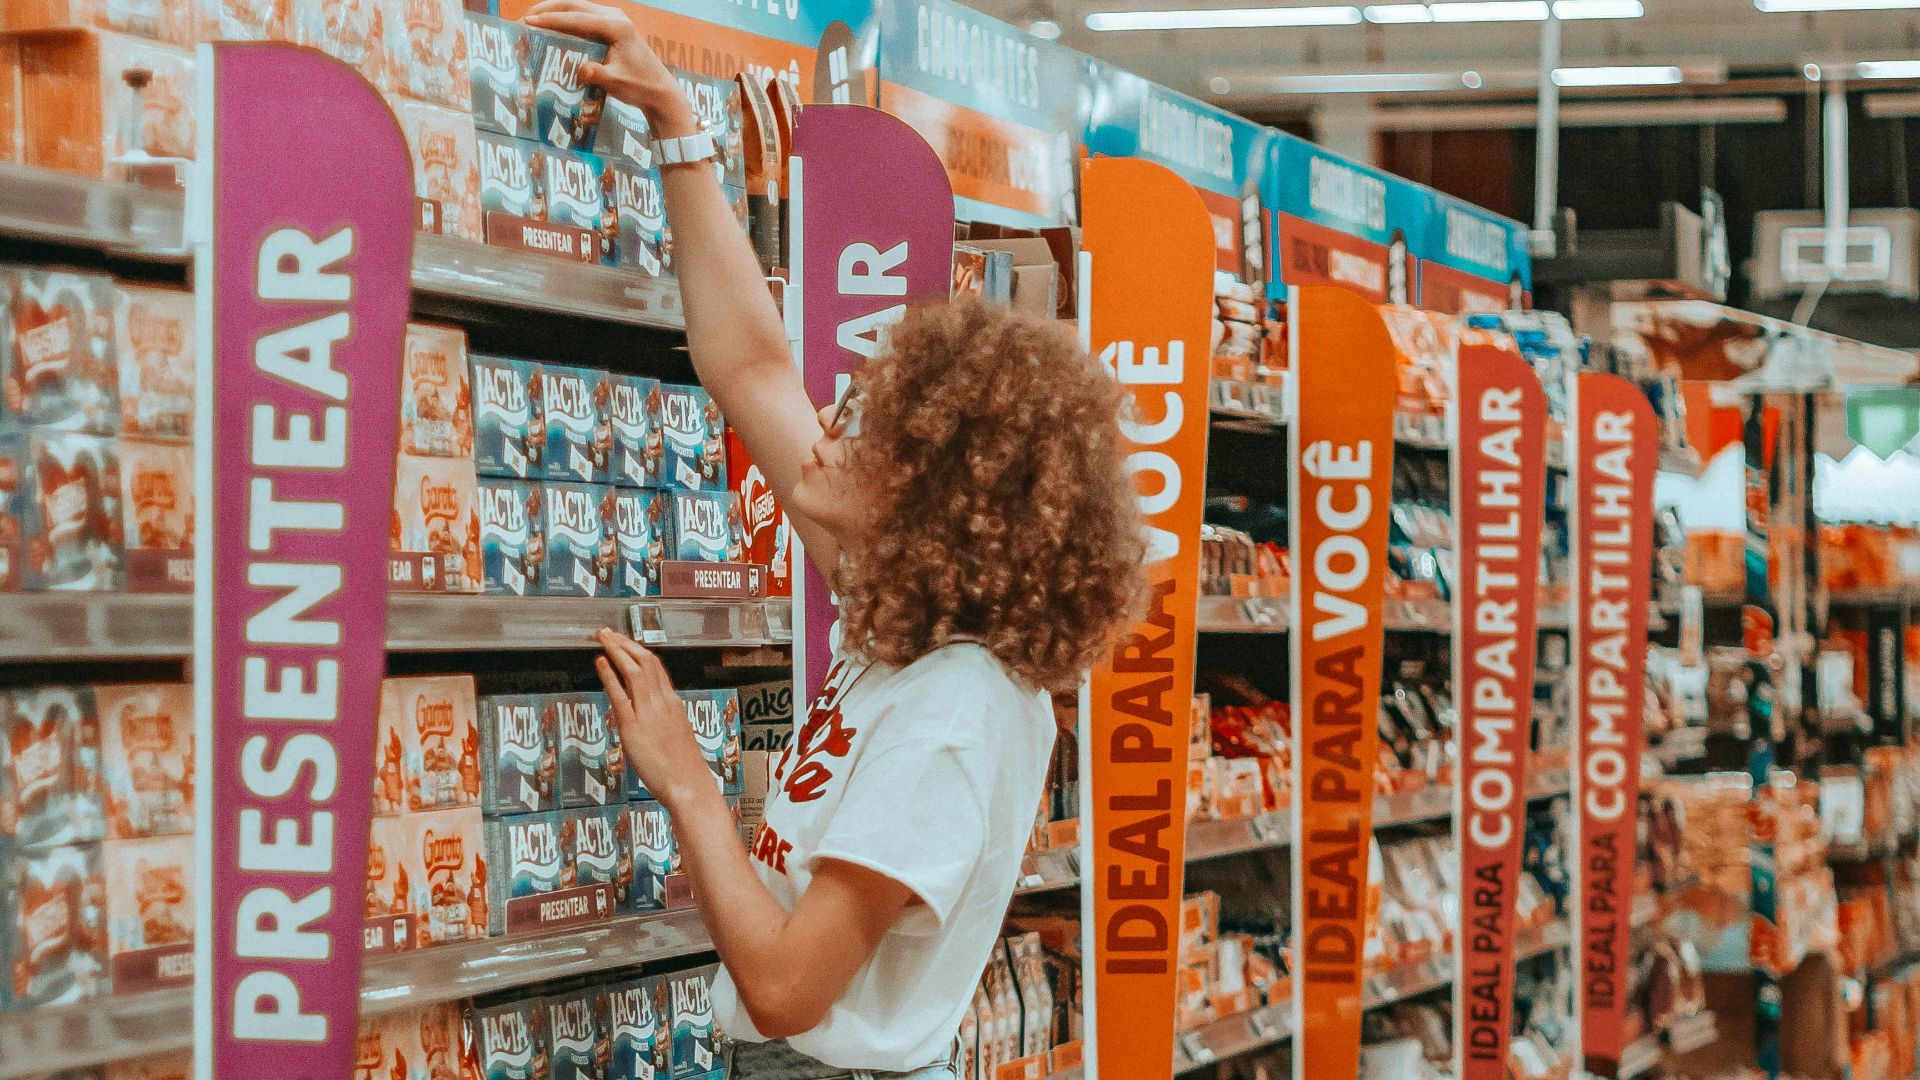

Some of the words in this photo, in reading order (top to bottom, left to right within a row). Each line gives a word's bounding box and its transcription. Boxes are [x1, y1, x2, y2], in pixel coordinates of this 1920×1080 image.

[537, 45, 589, 92] LACT
[679, 77, 724, 123] ACTA
[547, 156, 598, 205] LACTA
[614, 170, 661, 216] LACTA
[523, 226, 573, 254] PRESENTEAR
[475, 365, 526, 417] LACTA
[542, 374, 592, 423] LACTA
[609, 384, 643, 424] ACTA
[660, 394, 701, 432] ACTA
[478, 487, 524, 537] LACTA
[546, 488, 597, 538] LACTA
[616, 497, 646, 535] CTA
[678, 497, 730, 543] LACTA
[751, 489, 775, 525] Nestlé
[1302, 439, 1373, 642] VOCÊ
[694, 569, 742, 590] PRESENTEAR
[232, 226, 355, 1045] PRESENTEAR
[1469, 386, 1523, 849] COMPARTILHAR
[1585, 410, 1635, 821] COMPARTILHAR
[1110, 577, 1176, 764] PARA
[498, 705, 540, 758] LACTA
[557, 702, 604, 752] LACTA
[682, 700, 722, 737] ACTA
[1310, 644, 1365, 804] PARA
[509, 823, 558, 878] LACTA
[576, 816, 614, 856] ACTA
[629, 811, 669, 858] LACTA
[1105, 778, 1172, 975] IDEAL
[1589, 831, 1619, 915] PARA
[541, 896, 589, 922] PRESENTEAR
[1305, 818, 1361, 984] IDEAL
[1472, 861, 1505, 955] PARA
[1588, 923, 1617, 1010] IDEAL
[550, 998, 593, 1055] LACTA
[609, 986, 654, 1040] LACTA
[671, 976, 711, 1028] LACTA
[1470, 962, 1501, 1062] IDEAL
[482, 1011, 530, 1069] LACTA
